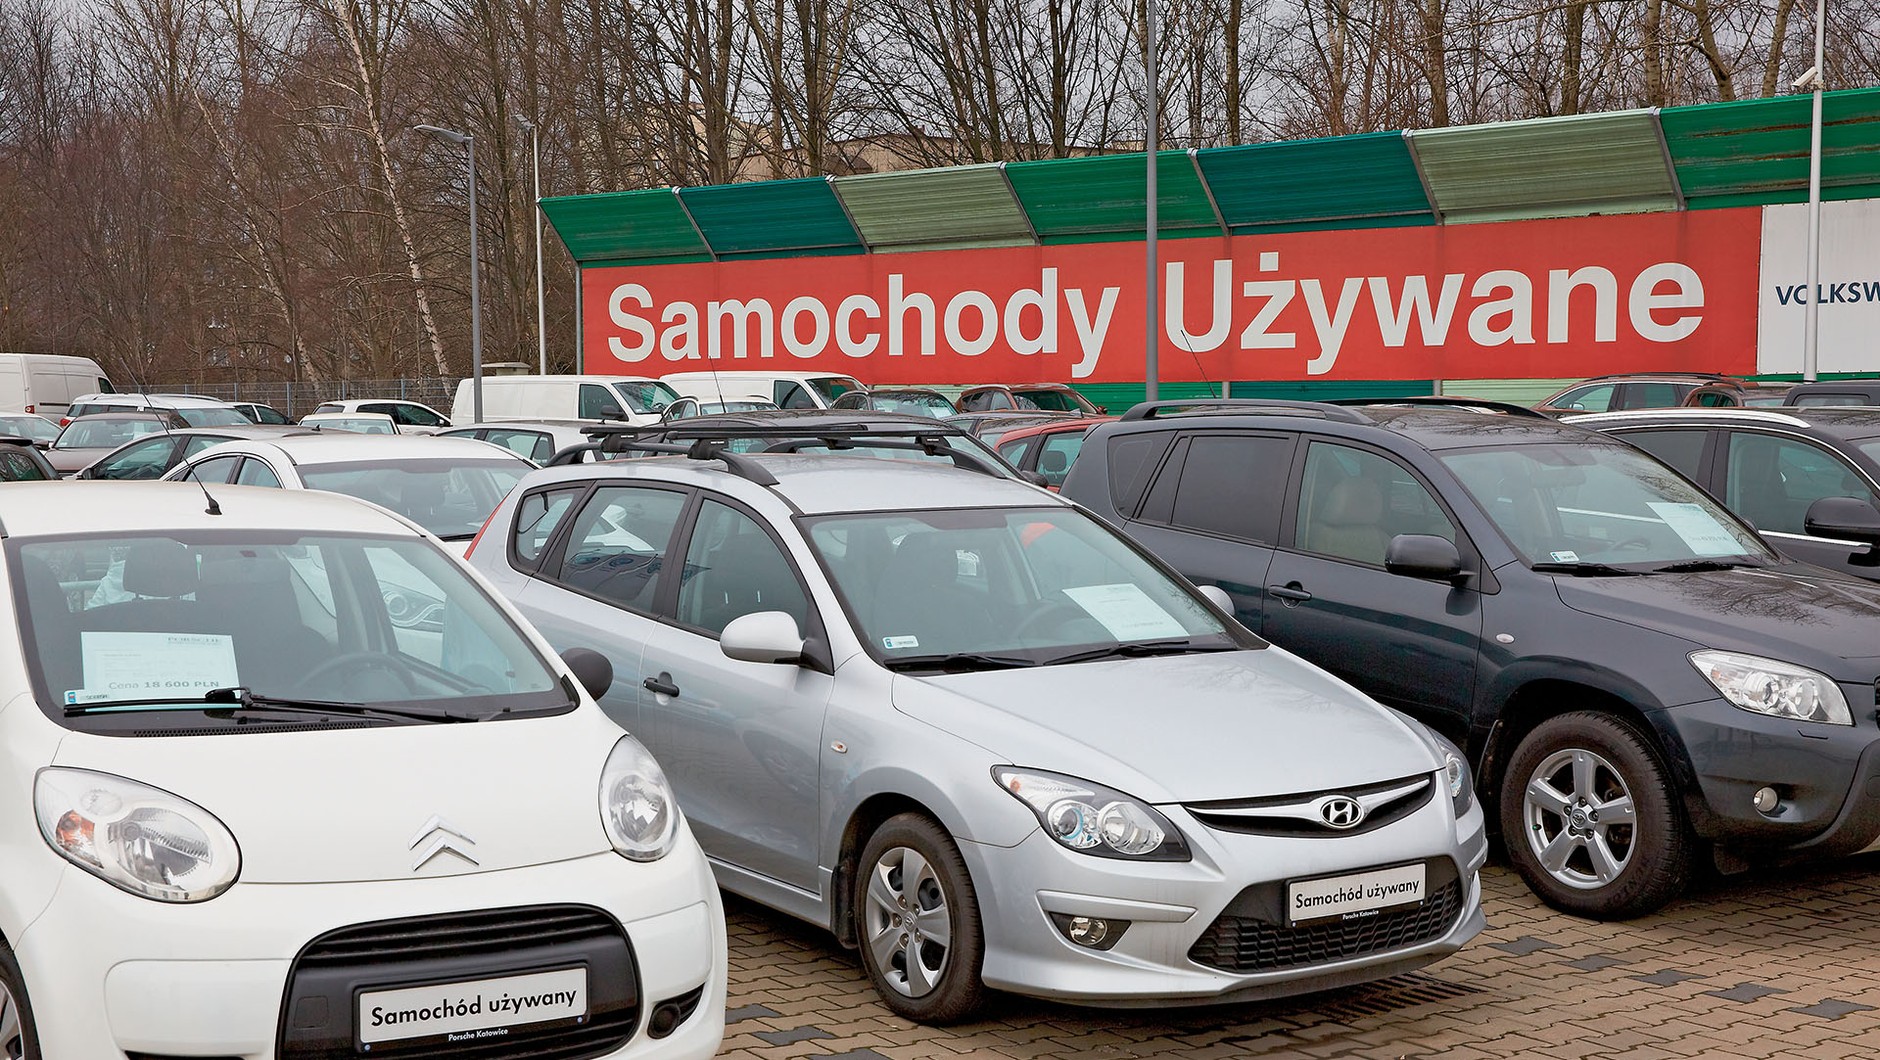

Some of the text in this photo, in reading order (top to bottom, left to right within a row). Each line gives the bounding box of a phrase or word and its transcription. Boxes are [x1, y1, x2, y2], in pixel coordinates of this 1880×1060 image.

[608, 251, 1705, 379] Samochody Używane
[108, 681, 139, 690] Cena
[144, 681, 160, 689] 18
[1295, 880, 1420, 909] Samochód używany
[371, 991, 577, 1028] Samochód używany
[448, 1028, 508, 1042] Porsche Katowice
